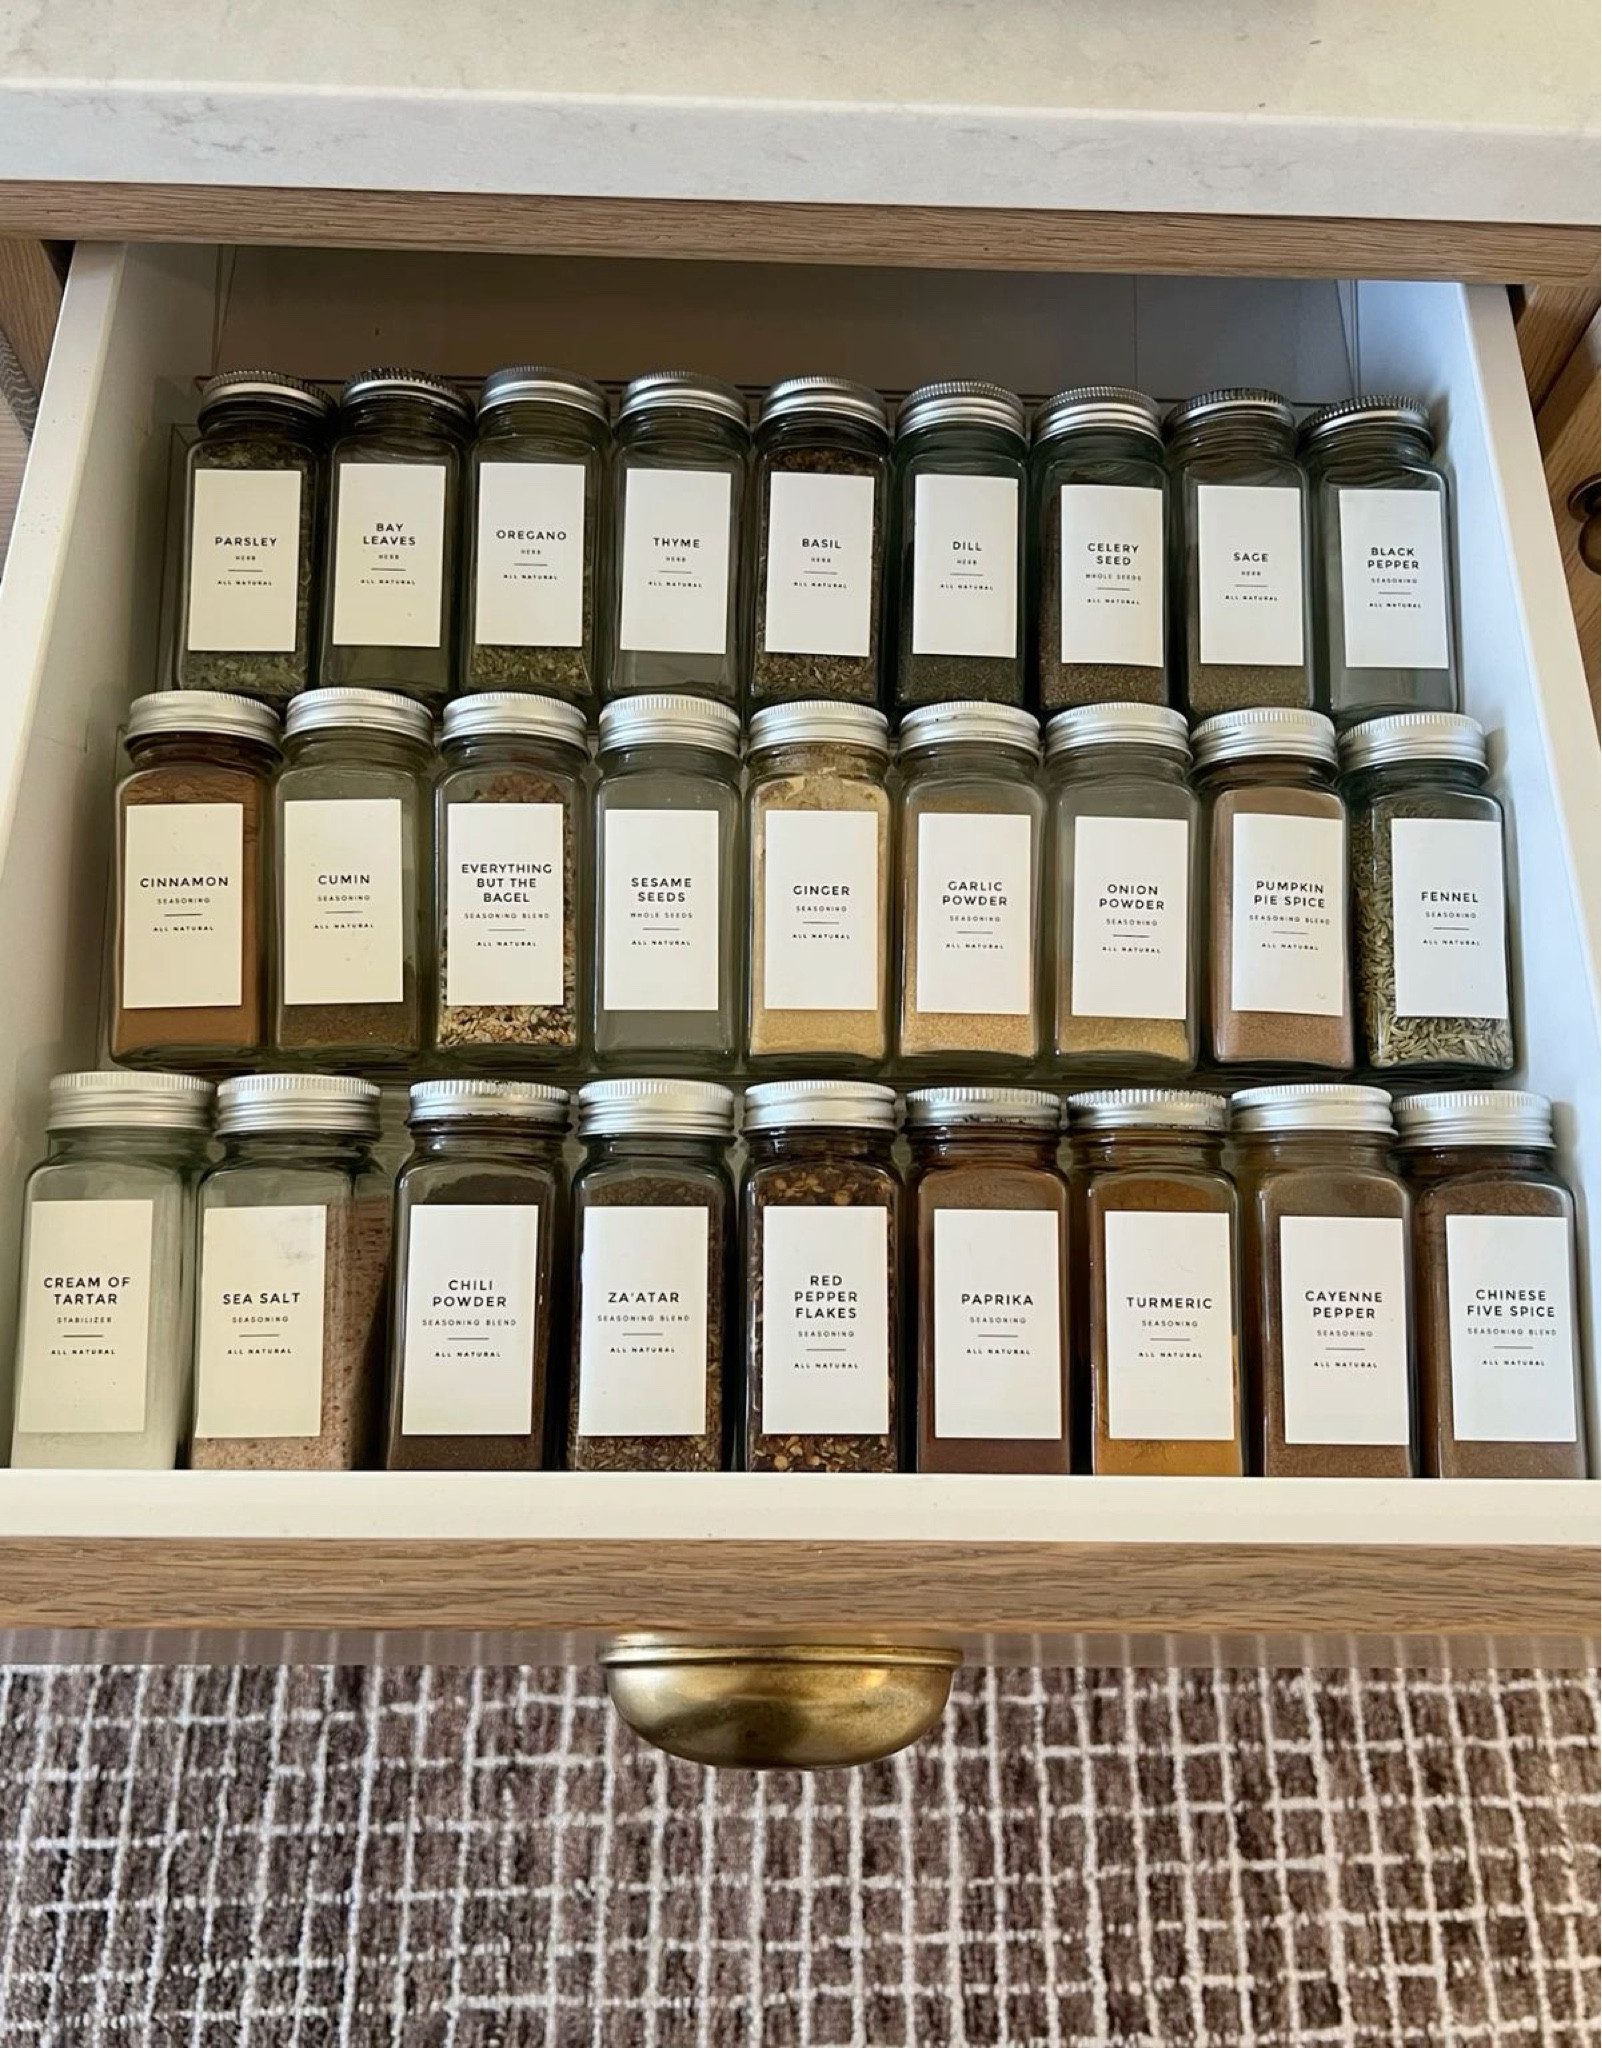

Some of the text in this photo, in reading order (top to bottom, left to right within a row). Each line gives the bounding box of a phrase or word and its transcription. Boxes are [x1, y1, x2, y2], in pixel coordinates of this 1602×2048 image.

[376, 523, 403, 533] BAY
[363, 535, 416, 546] LEAVES
[496, 529, 567, 541] OREGANO
[215, 536, 277, 547] PARSLEY
[652, 537, 700, 548] THYME
[802, 538, 842, 549] BASIL
[953, 541, 982, 552] DILL
[1087, 542, 1139, 554] CELERY
[1371, 547, 1415, 557] BLACK
[1096, 555, 1131, 566] SEED
[1233, 552, 1269, 563] SAGE
[1367, 559, 1419, 570] PEPPER
[461, 863, 552, 874] EVERYTHING
[140, 876, 228, 888] CINNAMON
[318, 874, 370, 885] CUMIN
[476, 878, 536, 888] BUT THE
[631, 877, 692, 888] SESAME
[793, 885, 850, 896] GINGER
[947, 880, 1002, 892] GARLIC
[1107, 883, 1158, 896] ONION
[1256, 880, 1324, 894] PUMPKIN
[157, 896, 210, 906] SEASONING
[317, 894, 370, 903] SEASONING
[483, 892, 530, 902] BAGEL
[637, 891, 685, 902] SEEDS
[942, 894, 1007, 906] POWDER
[1254, 894, 1325, 909] PIE SPICE
[1421, 891, 1479, 903] FENNEL
[796, 904, 847, 914] SEASONING
[1099, 898, 1164, 911] POWDER
[464, 912, 549, 920] SEASONING BLEND
[630, 910, 693, 919] WHOLE SEEDS
[950, 914, 1001, 923] SEASONING
[1249, 914, 1329, 926] SEASONING BLEND
[1425, 910, 1476, 919] SEASONING
[1106, 917, 1157, 927] SEASONING
[44, 1276, 131, 1289] CREAM OF
[448, 1279, 493, 1291] CHILI
[810, 1275, 842, 1287] RED
[53, 1293, 117, 1305] TARTAR
[222, 1292, 301, 1305] SEA SALT
[608, 1291, 679, 1303] ZA'ATAR
[794, 1290, 858, 1303] PEPPER
[961, 1293, 1034, 1306] PAPRIKA
[1305, 1290, 1382, 1303] CAYENNE
[1475, 1289, 1546, 1302] CHINESE
[432, 1295, 506, 1308] POWDER
[1126, 1297, 1212, 1309] TURMERIC
[795, 1307, 857, 1319] FLAKES
[1313, 1306, 1375, 1319] PEPPER
[1467, 1305, 1555, 1318] FIVE SPICE
[57, 1315, 111, 1325] STABILIZER
[232, 1315, 288, 1324] SEASONING
[422, 1317, 516, 1327] SEASONING BLEND
[597, 1313, 690, 1323] SEASONING BLEND
[970, 1315, 1026, 1325] SEASONING
[1142, 1318, 1198, 1329] SEASONING
[798, 1329, 854, 1339] SEASONING
[1317, 1328, 1373, 1338] SEASONING
[1467, 1326, 1556, 1337] SEASONING BLEND
